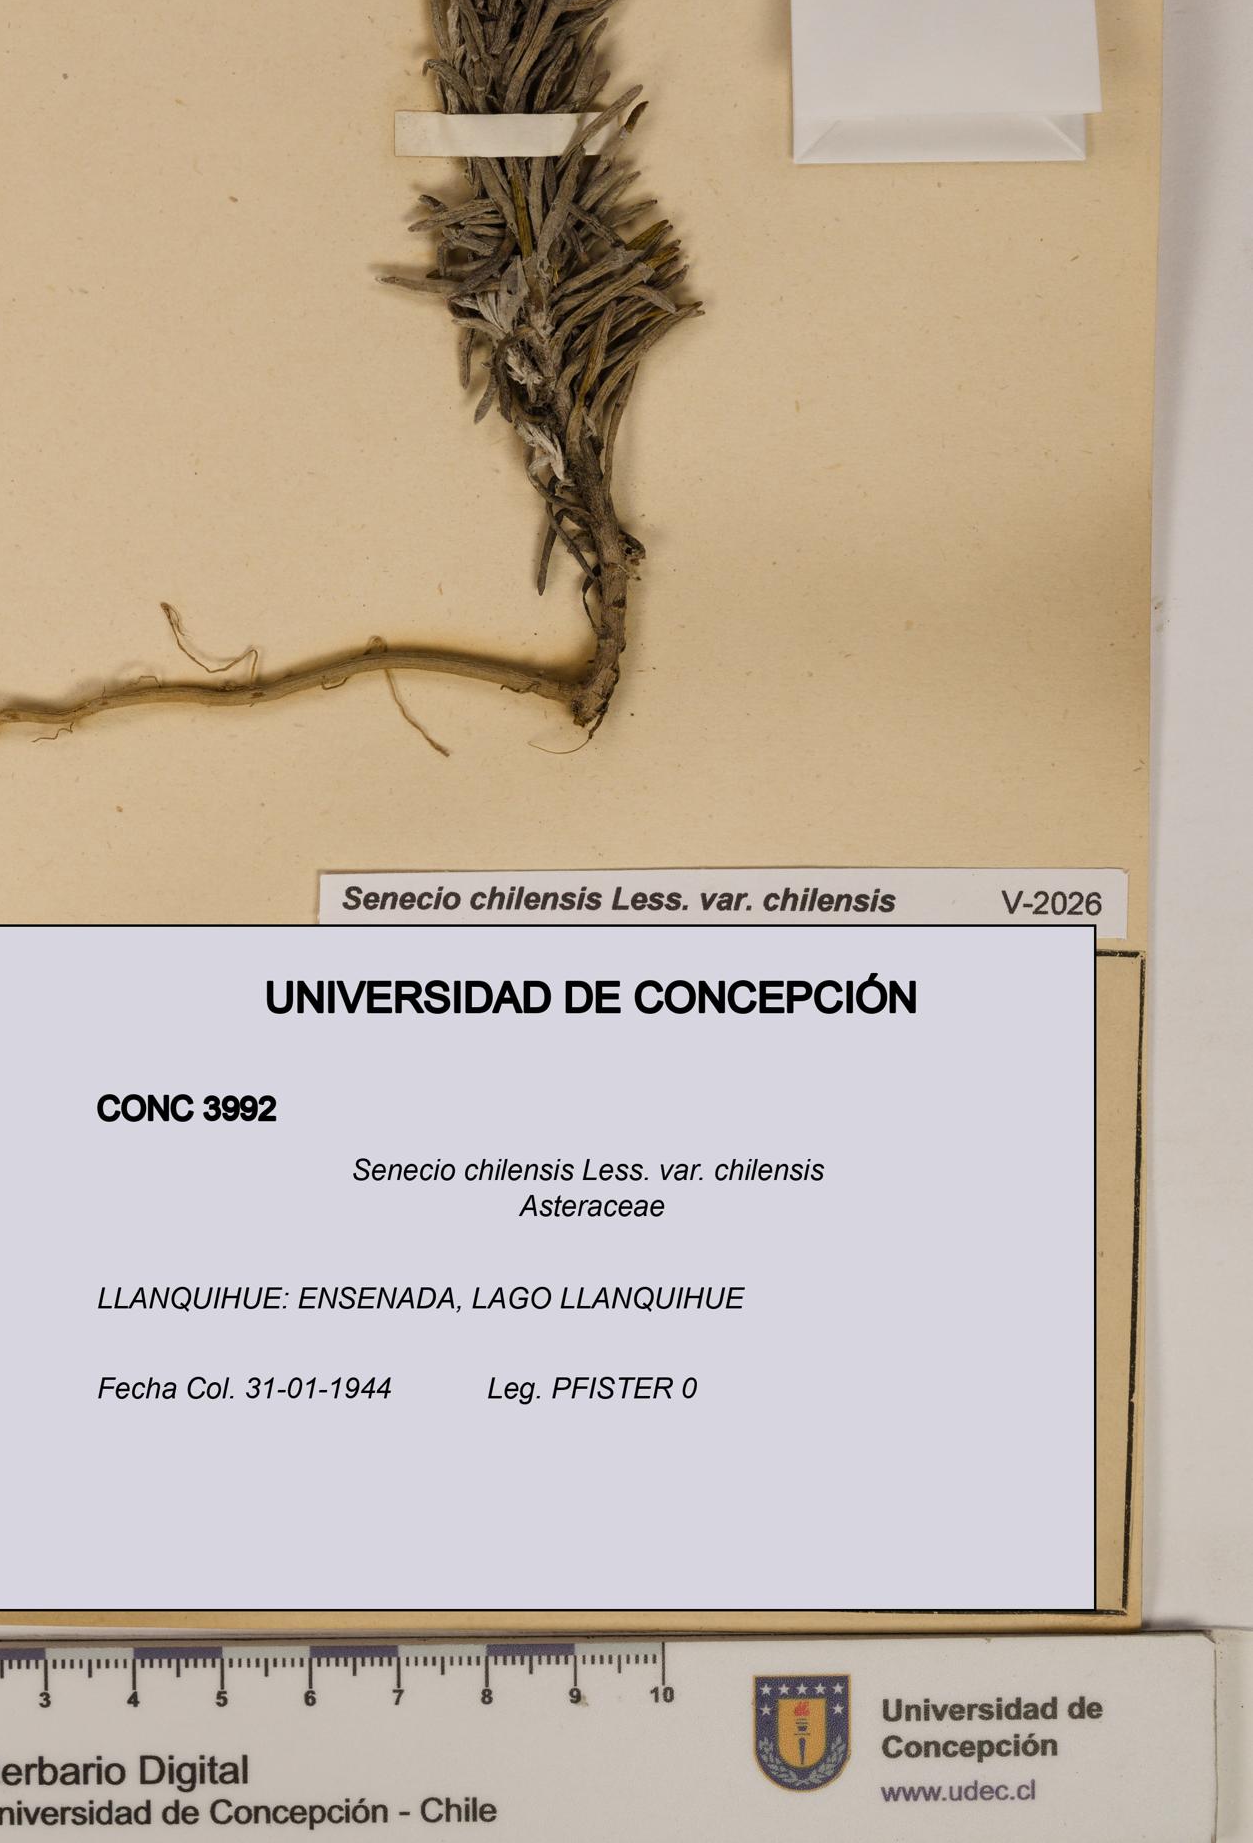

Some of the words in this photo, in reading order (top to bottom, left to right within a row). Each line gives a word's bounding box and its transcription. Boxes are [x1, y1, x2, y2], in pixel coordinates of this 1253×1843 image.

[341, 885, 462, 912] Senecio
[469, 885, 603, 912] chilensis
[611, 886, 689, 913] Less.
[700, 892, 753, 913] var.
[762, 886, 897, 914] chilensis
[1000, 890, 1103, 916] V-2026
[39, 1692, 52, 1708] 3
[126, 1691, 141, 1707] 4
[216, 1691, 229, 1707] 5
[303, 1690, 317, 1706] 6
[392, 1689, 405, 1705] 7
[480, 1689, 494, 1705] 8
[569, 1688, 583, 1704] 9
[650, 1687, 675, 1703] 10
[882, 1697, 1058, 1722] Universidad
[1067, 1696, 1104, 1720] de
[882, 1733, 1058, 1763] Concepción
[139, 1754, 249, 1793] Digital
[880, 1779, 1036, 1803] www.udec.cl
[161, 1798, 200, 1826] de
[209, 1797, 389, 1831] Concepción
[420, 1796, 498, 1824] Chile
